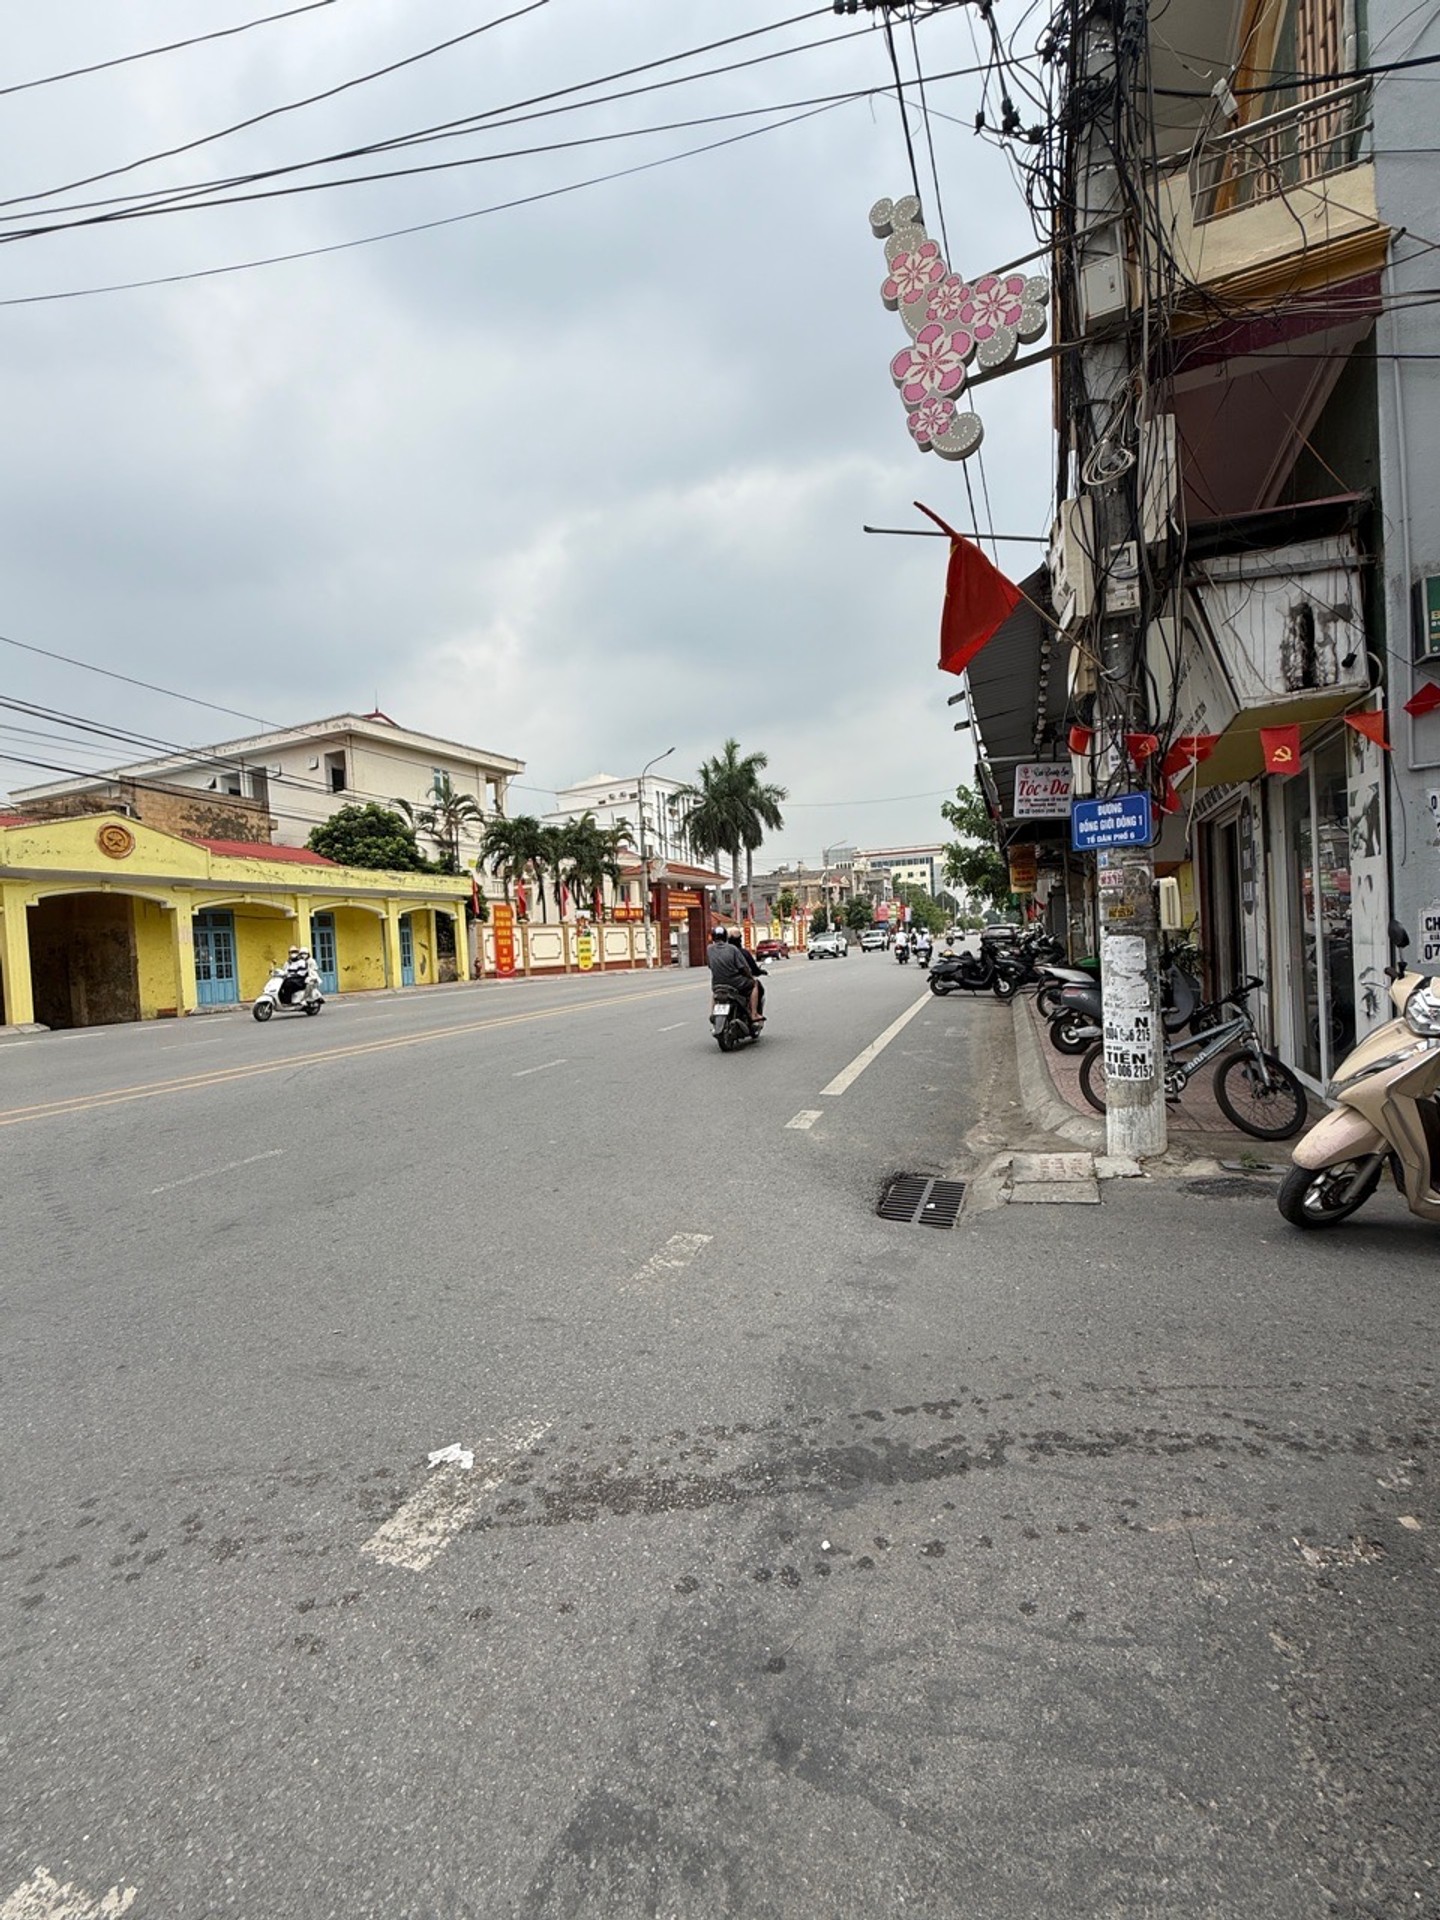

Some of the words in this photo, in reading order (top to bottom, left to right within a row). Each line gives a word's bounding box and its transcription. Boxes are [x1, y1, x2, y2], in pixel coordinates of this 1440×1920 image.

[1019, 780, 1041, 796] Tóc
[1050, 779, 1070, 795] Da
[1138, 815, 1143, 826] 1
